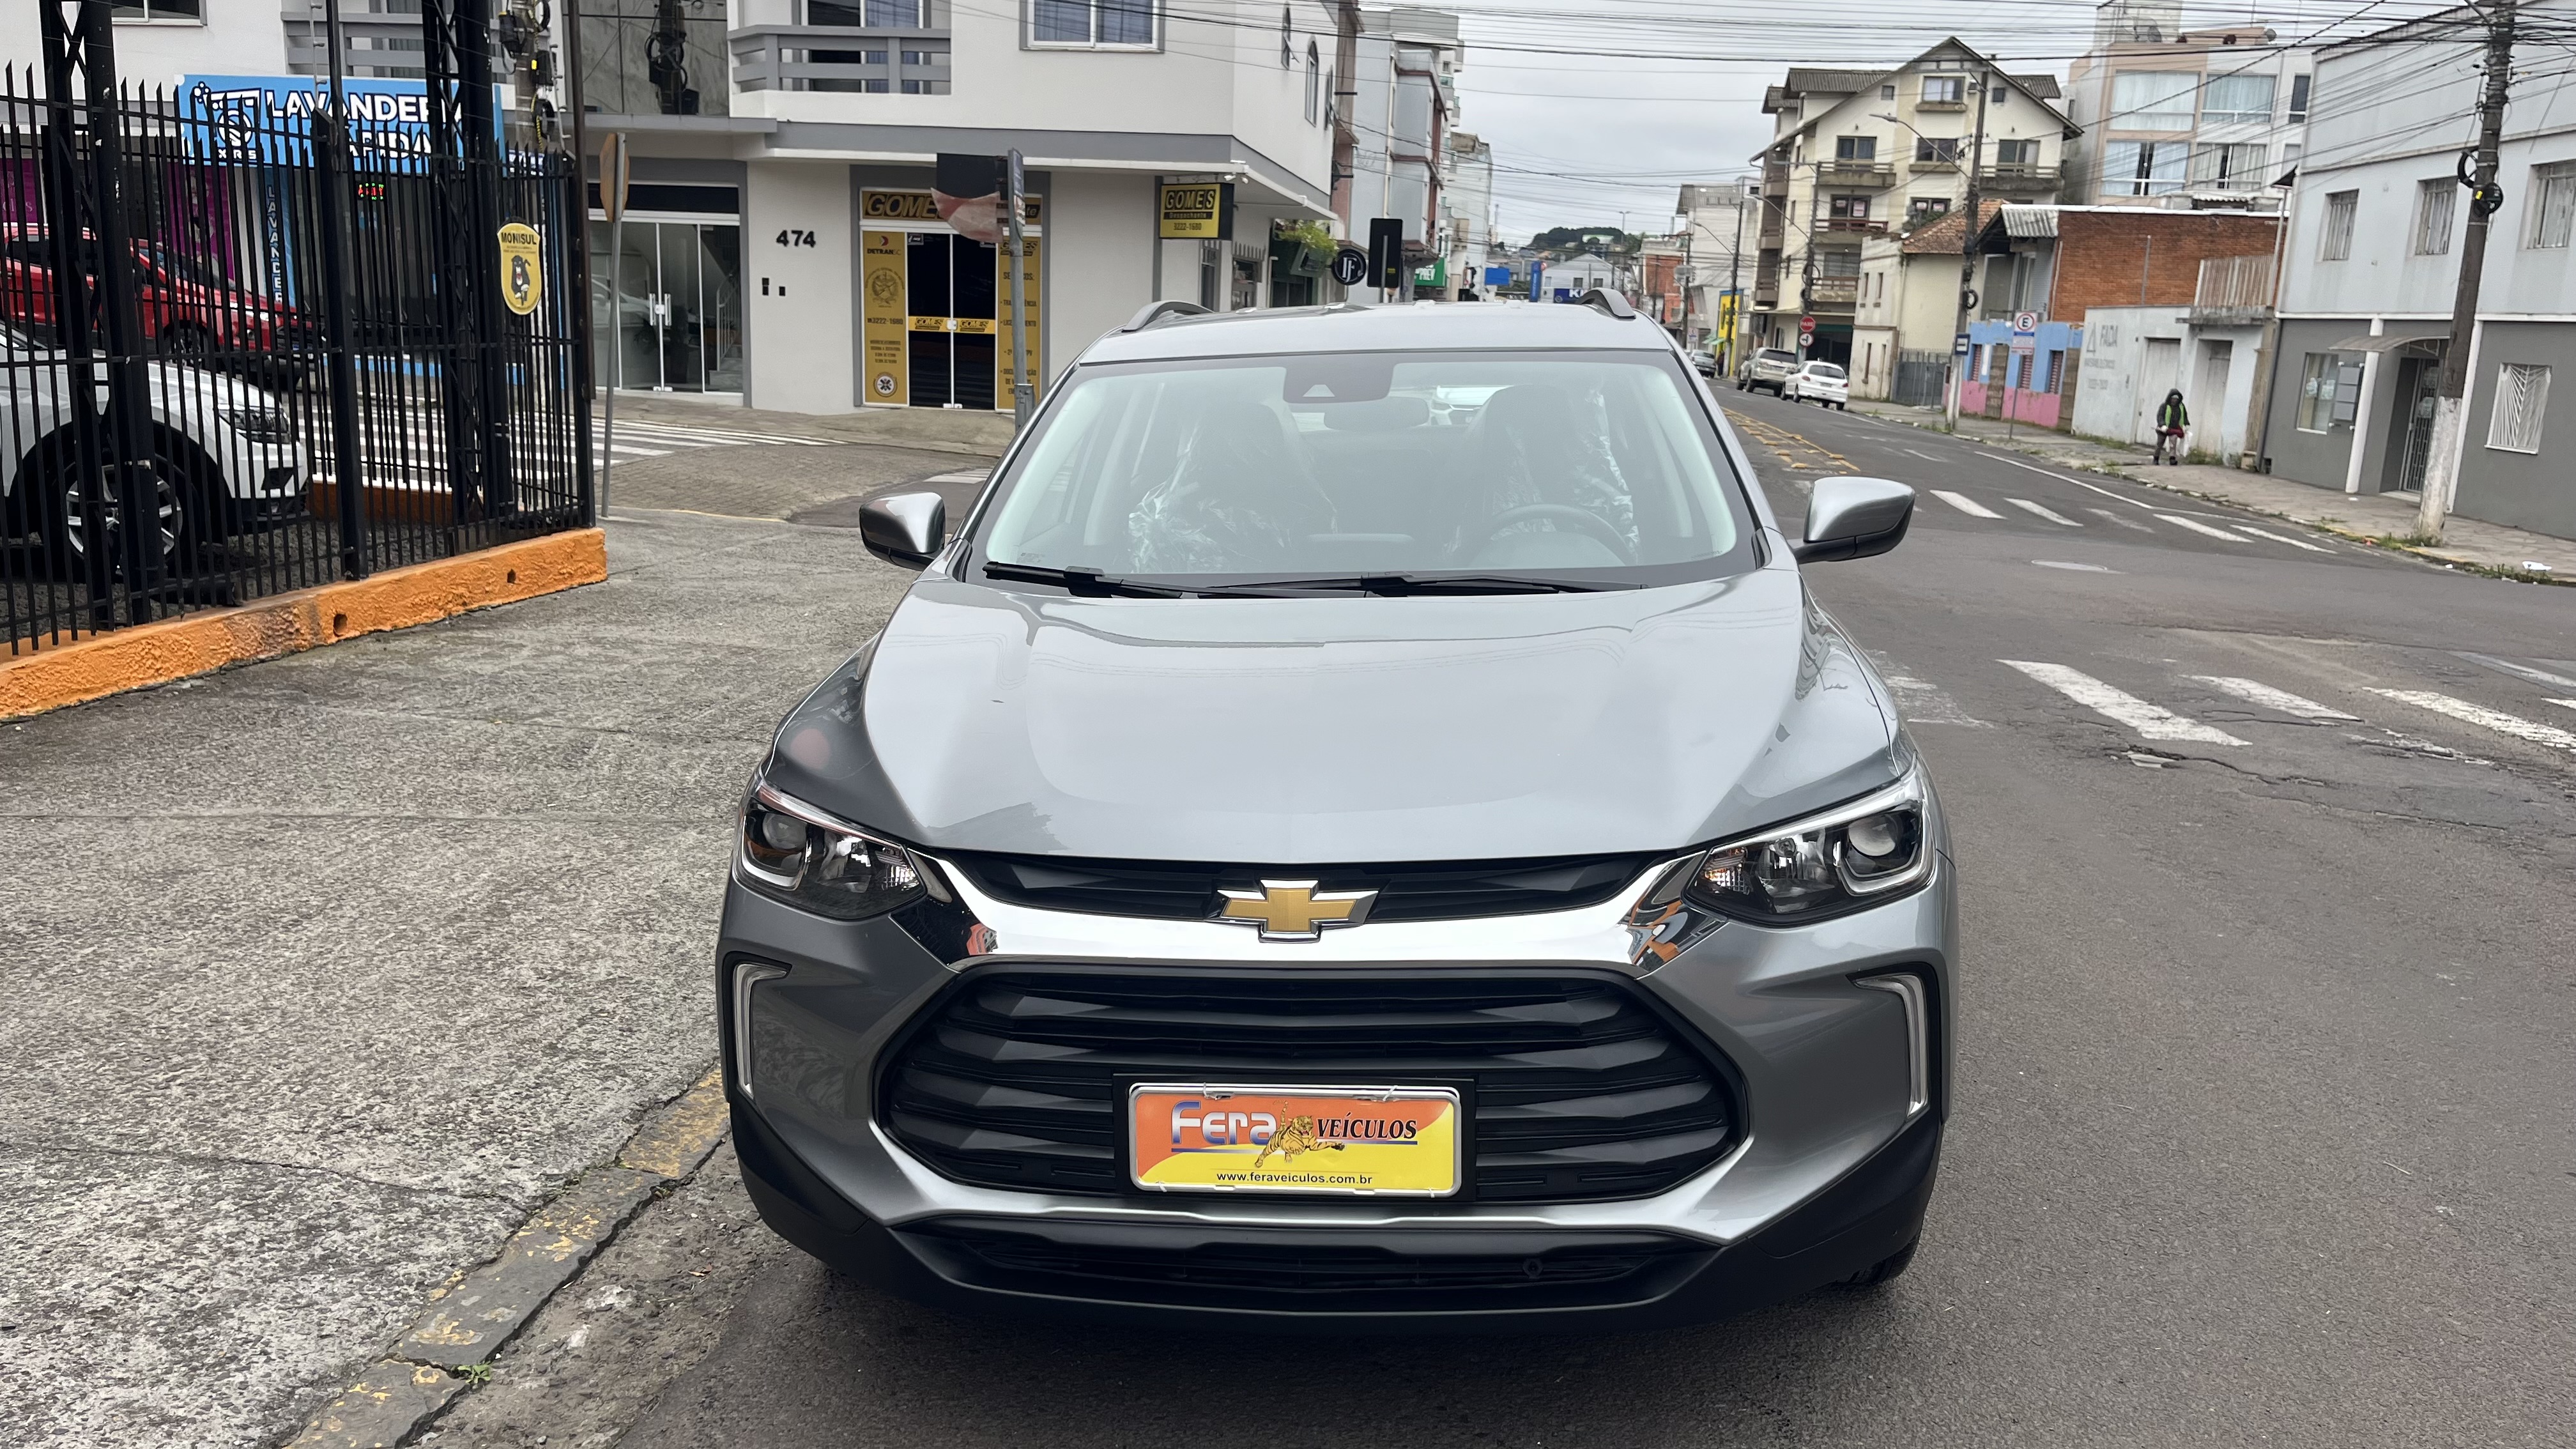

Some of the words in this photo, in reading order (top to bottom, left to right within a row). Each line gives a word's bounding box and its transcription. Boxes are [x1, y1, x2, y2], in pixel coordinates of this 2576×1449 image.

[866, 194, 944, 218] GOME
[1166, 190, 1215, 209] GOMES
[501, 231, 537, 246] MONISUL
[776, 230, 816, 248] 474
[1000, 241, 1037, 250] GES
[2021, 317, 2029, 328] E
[1317, 1112, 1418, 1138] VEÍCULOS
[1216, 1171, 1373, 1184] www.feraveiculos.com.br
